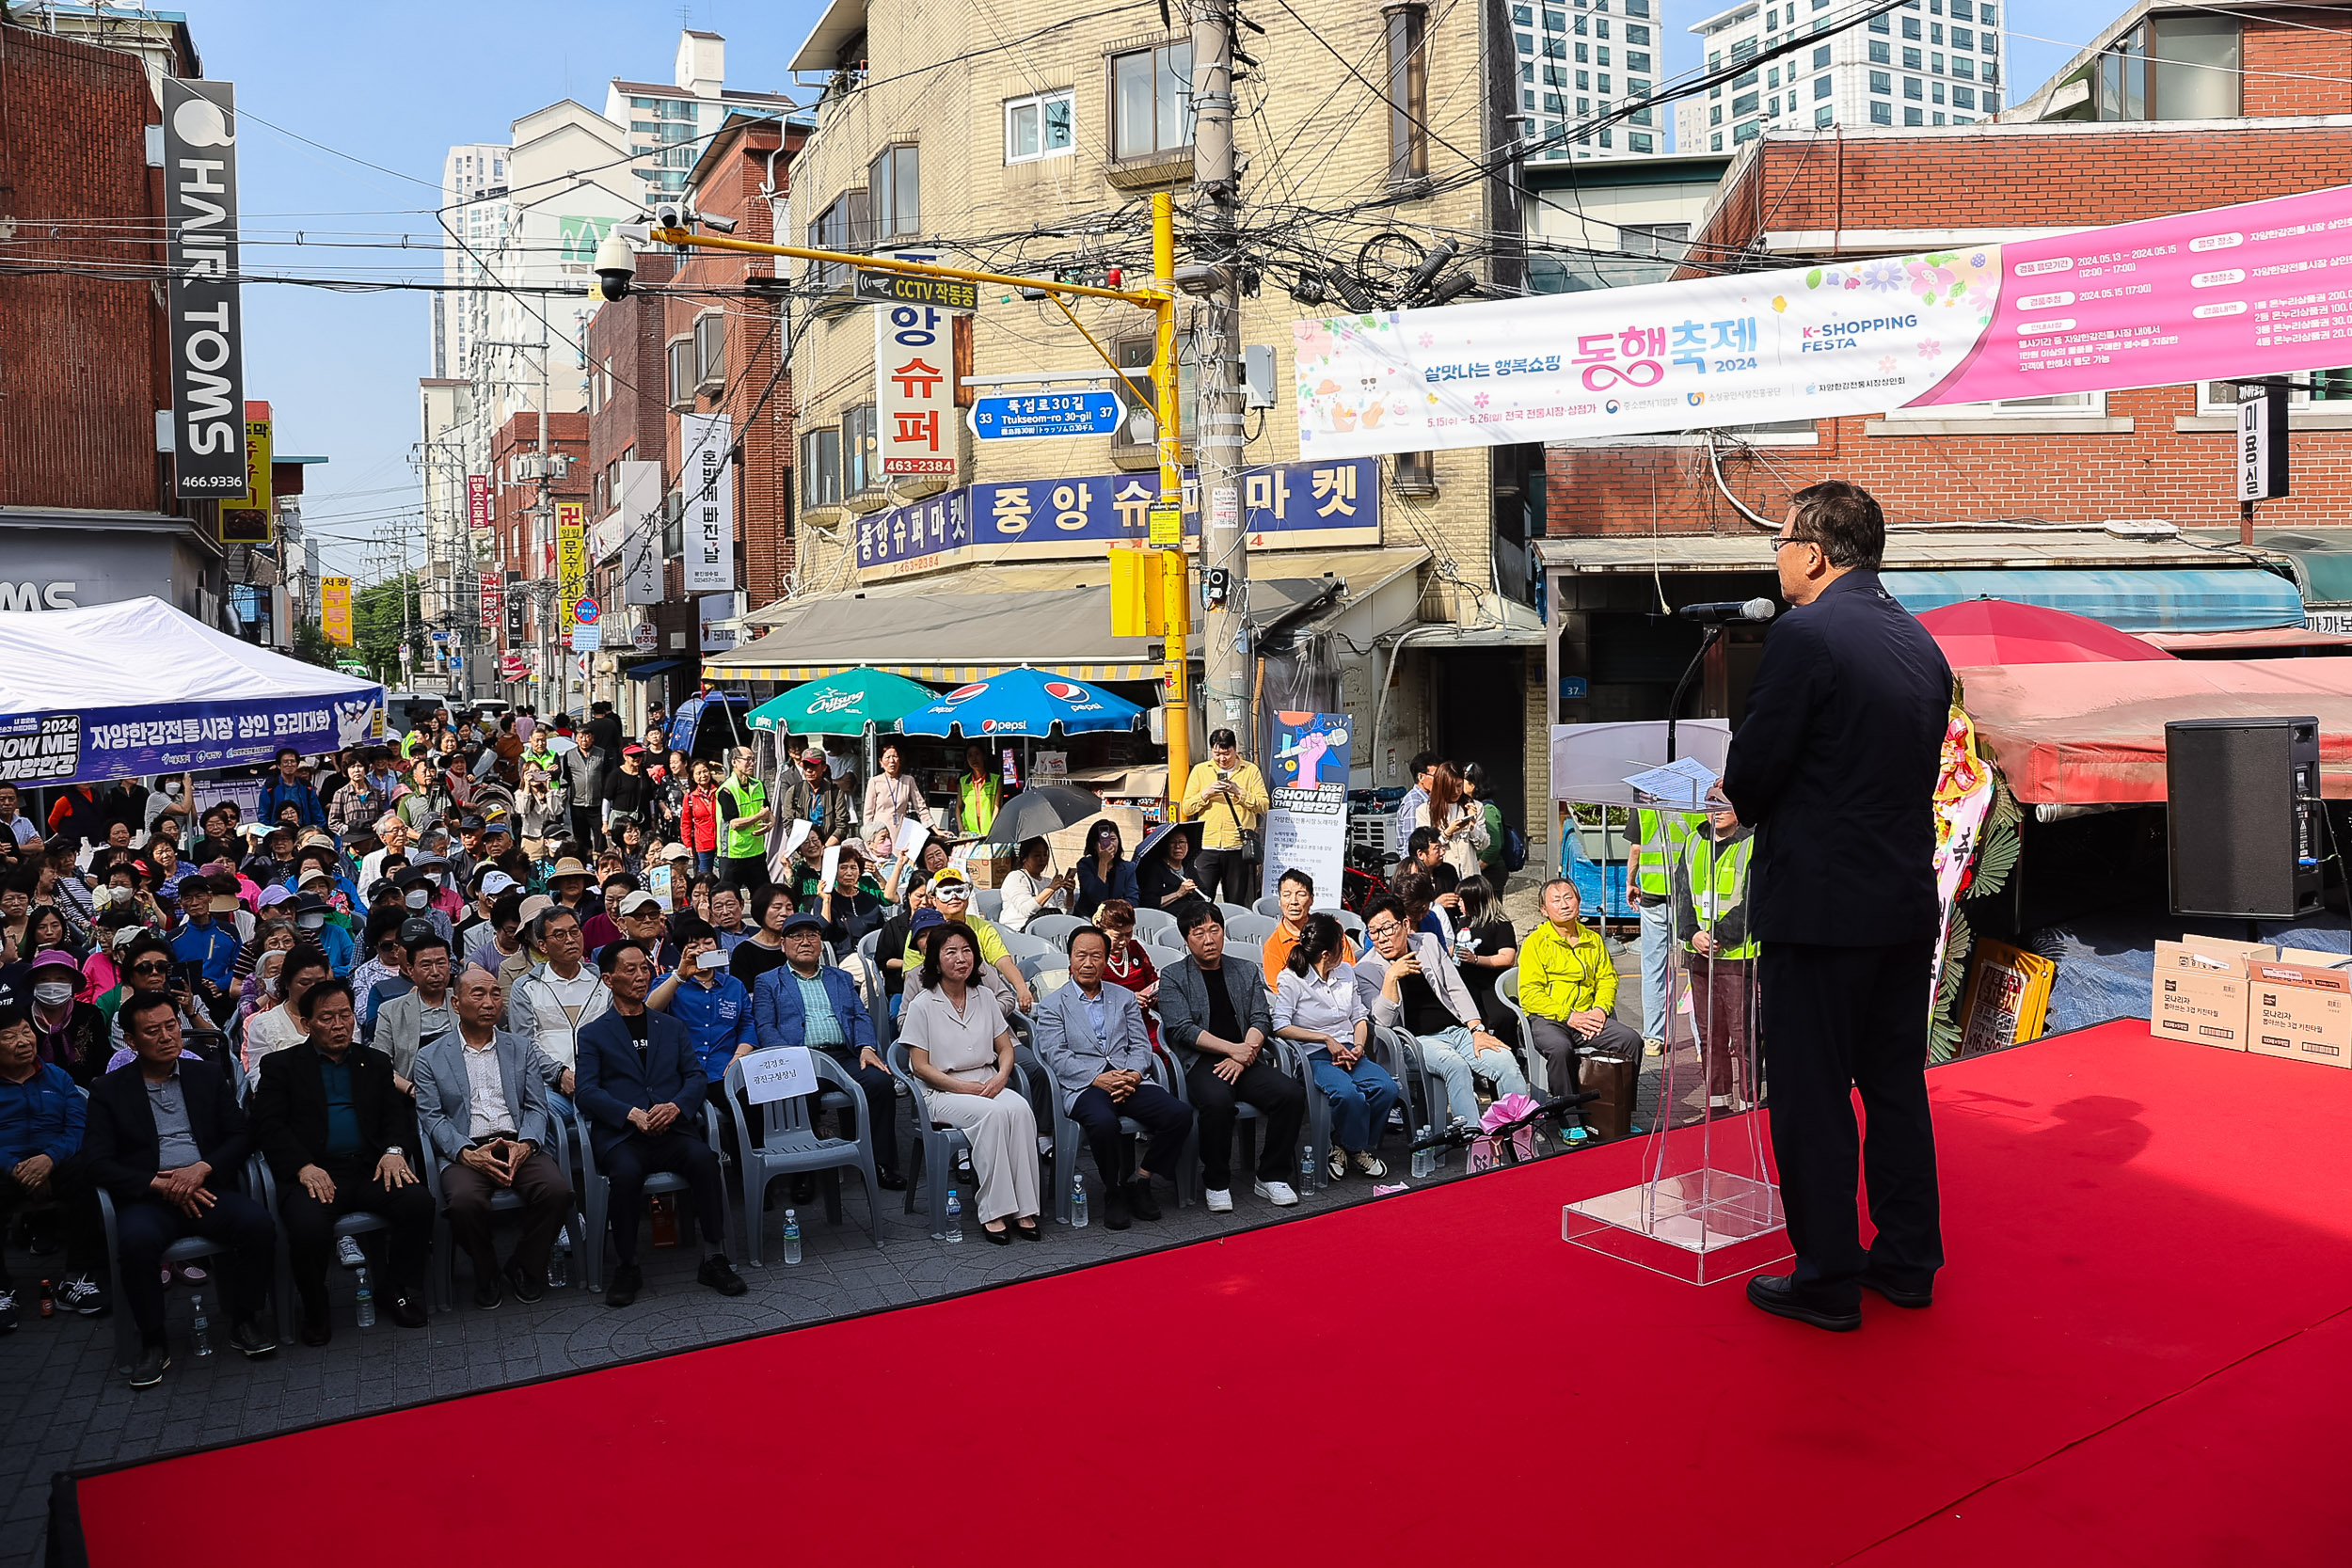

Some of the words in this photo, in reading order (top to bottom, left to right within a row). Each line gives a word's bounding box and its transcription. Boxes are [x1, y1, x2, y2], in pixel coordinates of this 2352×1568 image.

[2077, 253, 2122, 266] 2024.05.13
[2131, 245, 2177, 259] 2024.05.15
[896, 279, 933, 300] CCTV
[935, 283, 975, 308] 작동중
[2079, 288, 2122, 301] 2024.05.15
[1803, 314, 1917, 339] K-SHOPPING
[890, 253, 944, 451] 앙슈퍼
[1802, 337, 1857, 353] FESTA
[1571, 317, 1756, 391] 동행축제
[1424, 362, 1490, 383] 살맛나는
[1495, 356, 1561, 376] 행복쇼핑
[1715, 357, 1757, 372] 2024
[1819, 376, 1906, 393] 자양한강전통시장상인회
[1708, 387, 1782, 403] 소상공인시장진흥공단
[1008, 395, 1085, 415] 뚝섬로30길
[1623, 397, 1678, 412] 중소벤처기업부
[978, 413, 993, 424] 33
[1001, 415, 1061, 425] Ttukseom-ro
[1064, 410, 1092, 423] 30-gil
[1099, 406, 1114, 419] 37
[1505, 409, 1523, 420] 전국
[2245, 403, 2259, 495] 미용실
[886, 460, 952, 473] 463-2384
[183, 476, 242, 488] 466.9336
[861, 494, 965, 561] 중앙슈퍼마켓
[326, 589, 349, 642] 부동산
[1566, 687, 1580, 696] 37
[1070, 703, 1104, 712] pepsi
[41, 719, 77, 734] 2024
[89, 717, 233, 751] 자양한강전통시장
[238, 714, 270, 737] 상인
[273, 709, 330, 736] 요리대회
[998, 720, 1027, 731] pepsi
[41, 734, 77, 755] ME
[1273, 788, 1317, 800] SHOW
[1317, 791, 1343, 803] ME
[1318, 784, 1343, 793] 2024
[2164, 993, 2190, 1005] 모나리자
[2263, 1009, 2292, 1021] 모나리자
